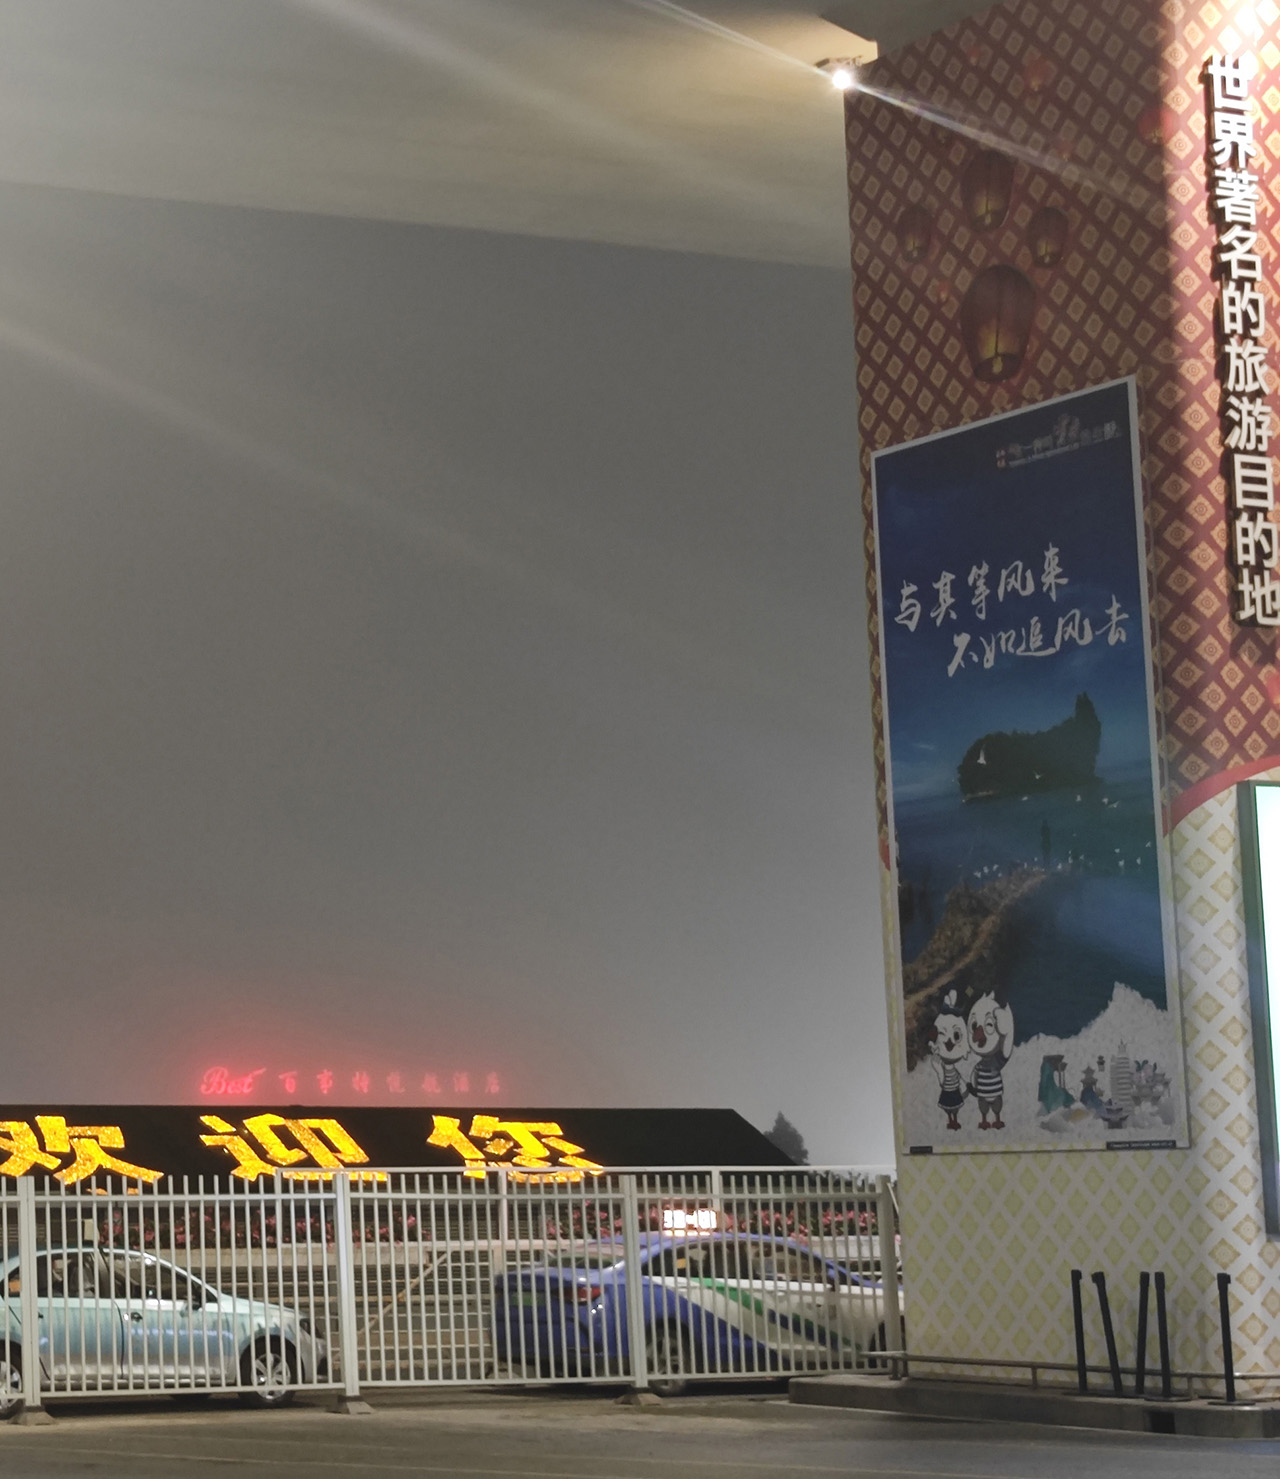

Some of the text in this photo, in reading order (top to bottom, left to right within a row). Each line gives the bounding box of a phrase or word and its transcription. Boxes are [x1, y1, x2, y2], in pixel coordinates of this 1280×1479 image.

[1207, 52, 1280, 626] 世界著名的旅游目的地
[894, 542, 1069, 632] 与其等风来
[947, 594, 1129, 677] 不如追风去
[200, 1066, 266, 1094] Best
